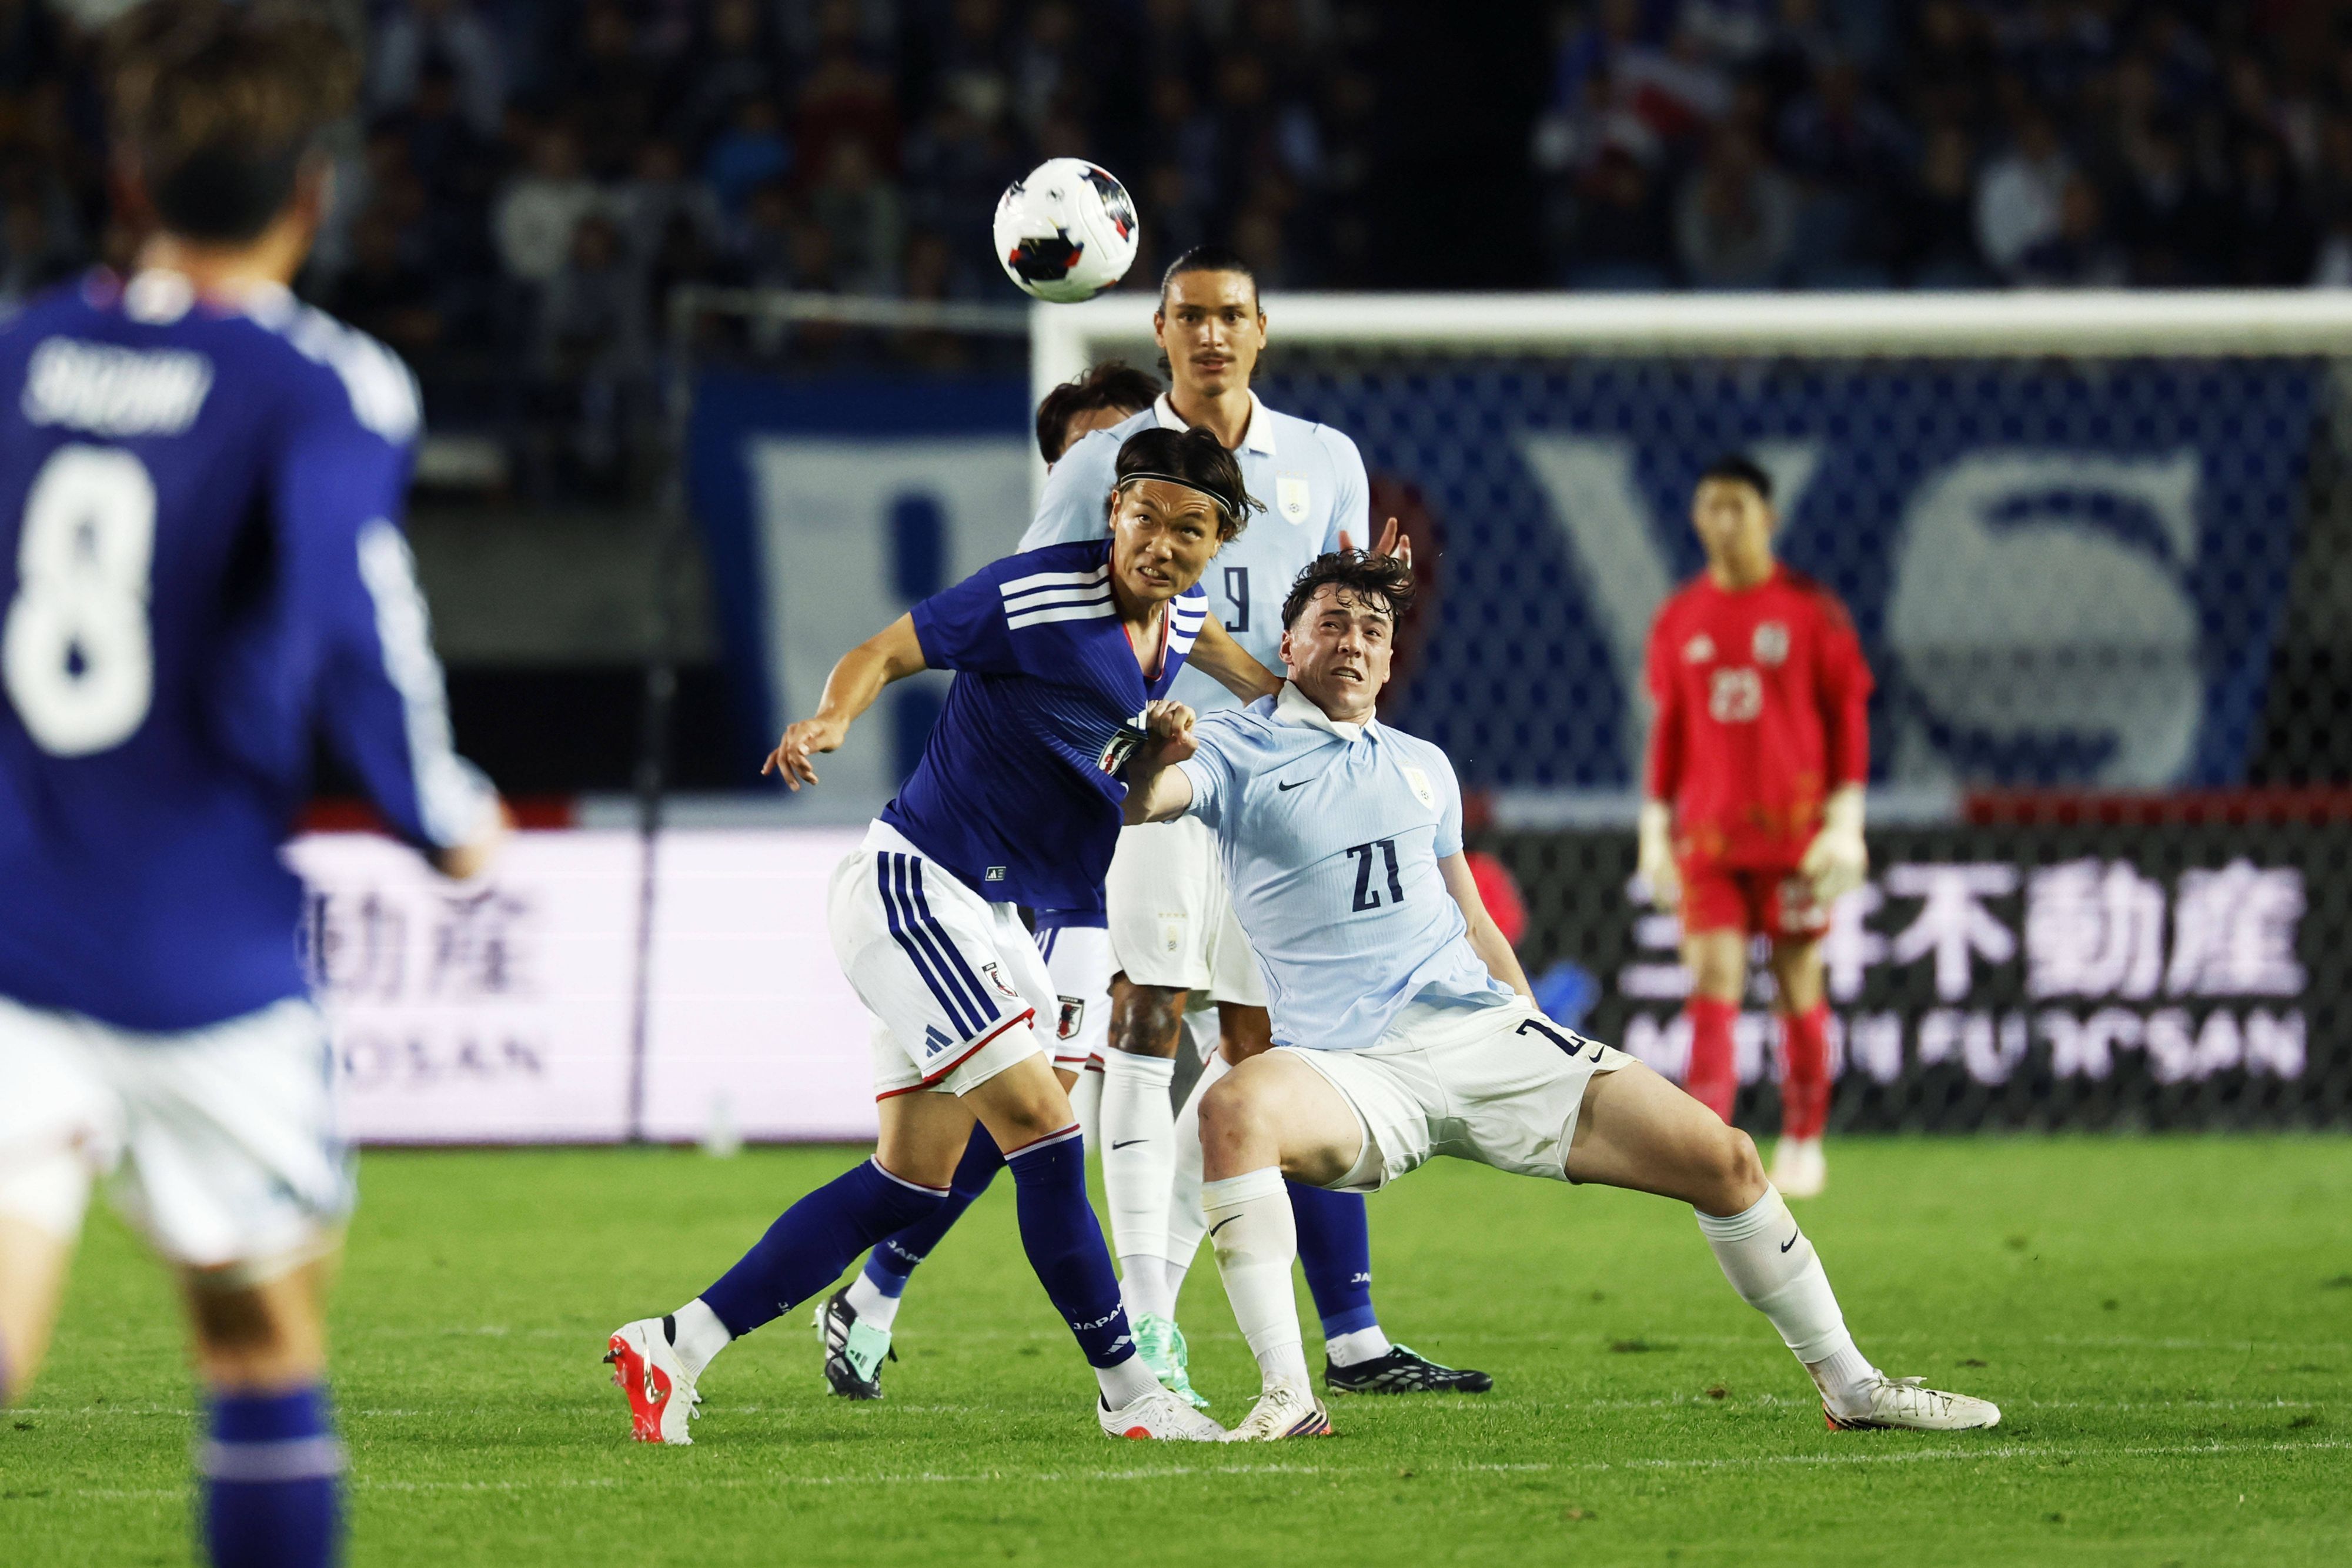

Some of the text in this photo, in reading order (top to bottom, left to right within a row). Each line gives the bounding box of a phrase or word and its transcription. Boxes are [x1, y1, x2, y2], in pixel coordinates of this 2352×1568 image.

[5, 444, 156, 756] 8
[1224, 567, 1250, 633] 9
[1347, 840, 1405, 912] 21
